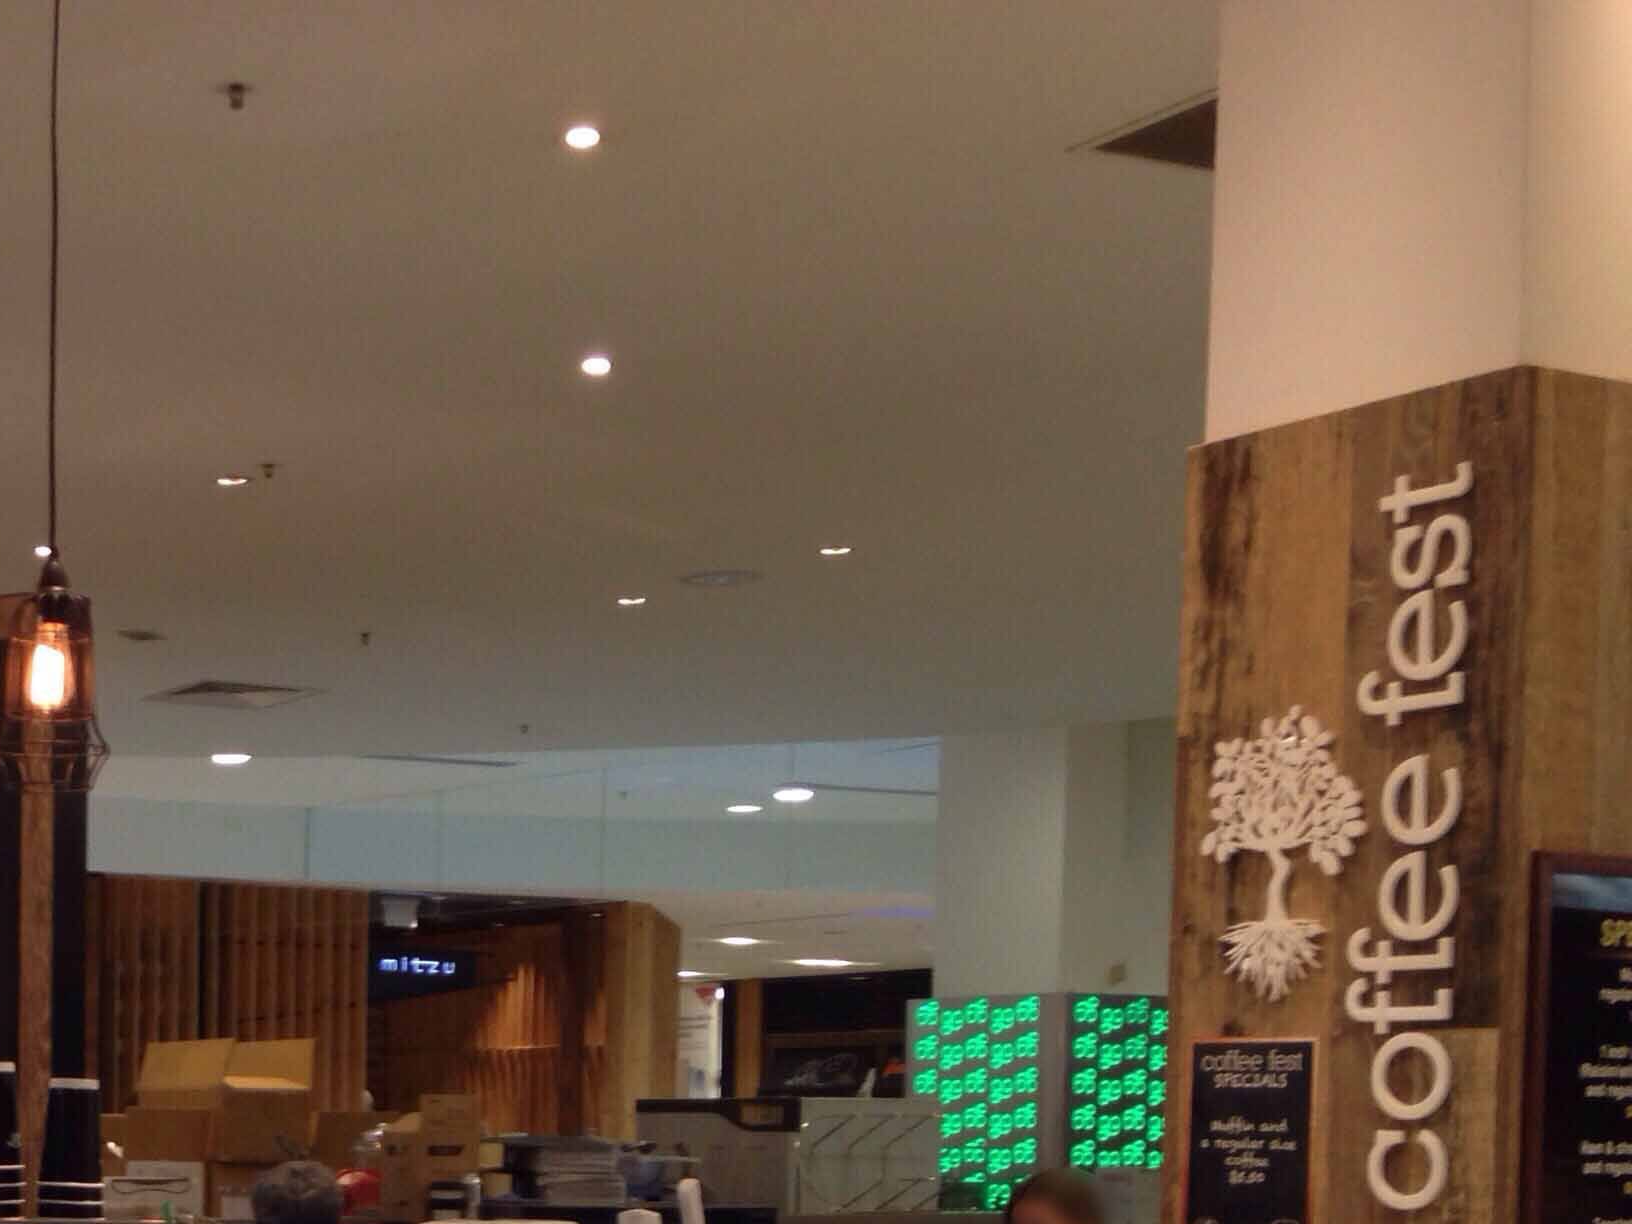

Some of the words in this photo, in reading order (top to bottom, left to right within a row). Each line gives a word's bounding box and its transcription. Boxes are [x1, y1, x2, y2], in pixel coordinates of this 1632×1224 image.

[1358, 461, 1473, 725] fest
[1345, 753, 1462, 1212] coffee
[1200, 1049, 1265, 1072] coffee
[1268, 1049, 1303, 1072] fest
[1213, 1072, 1288, 1088] SPECIALS
